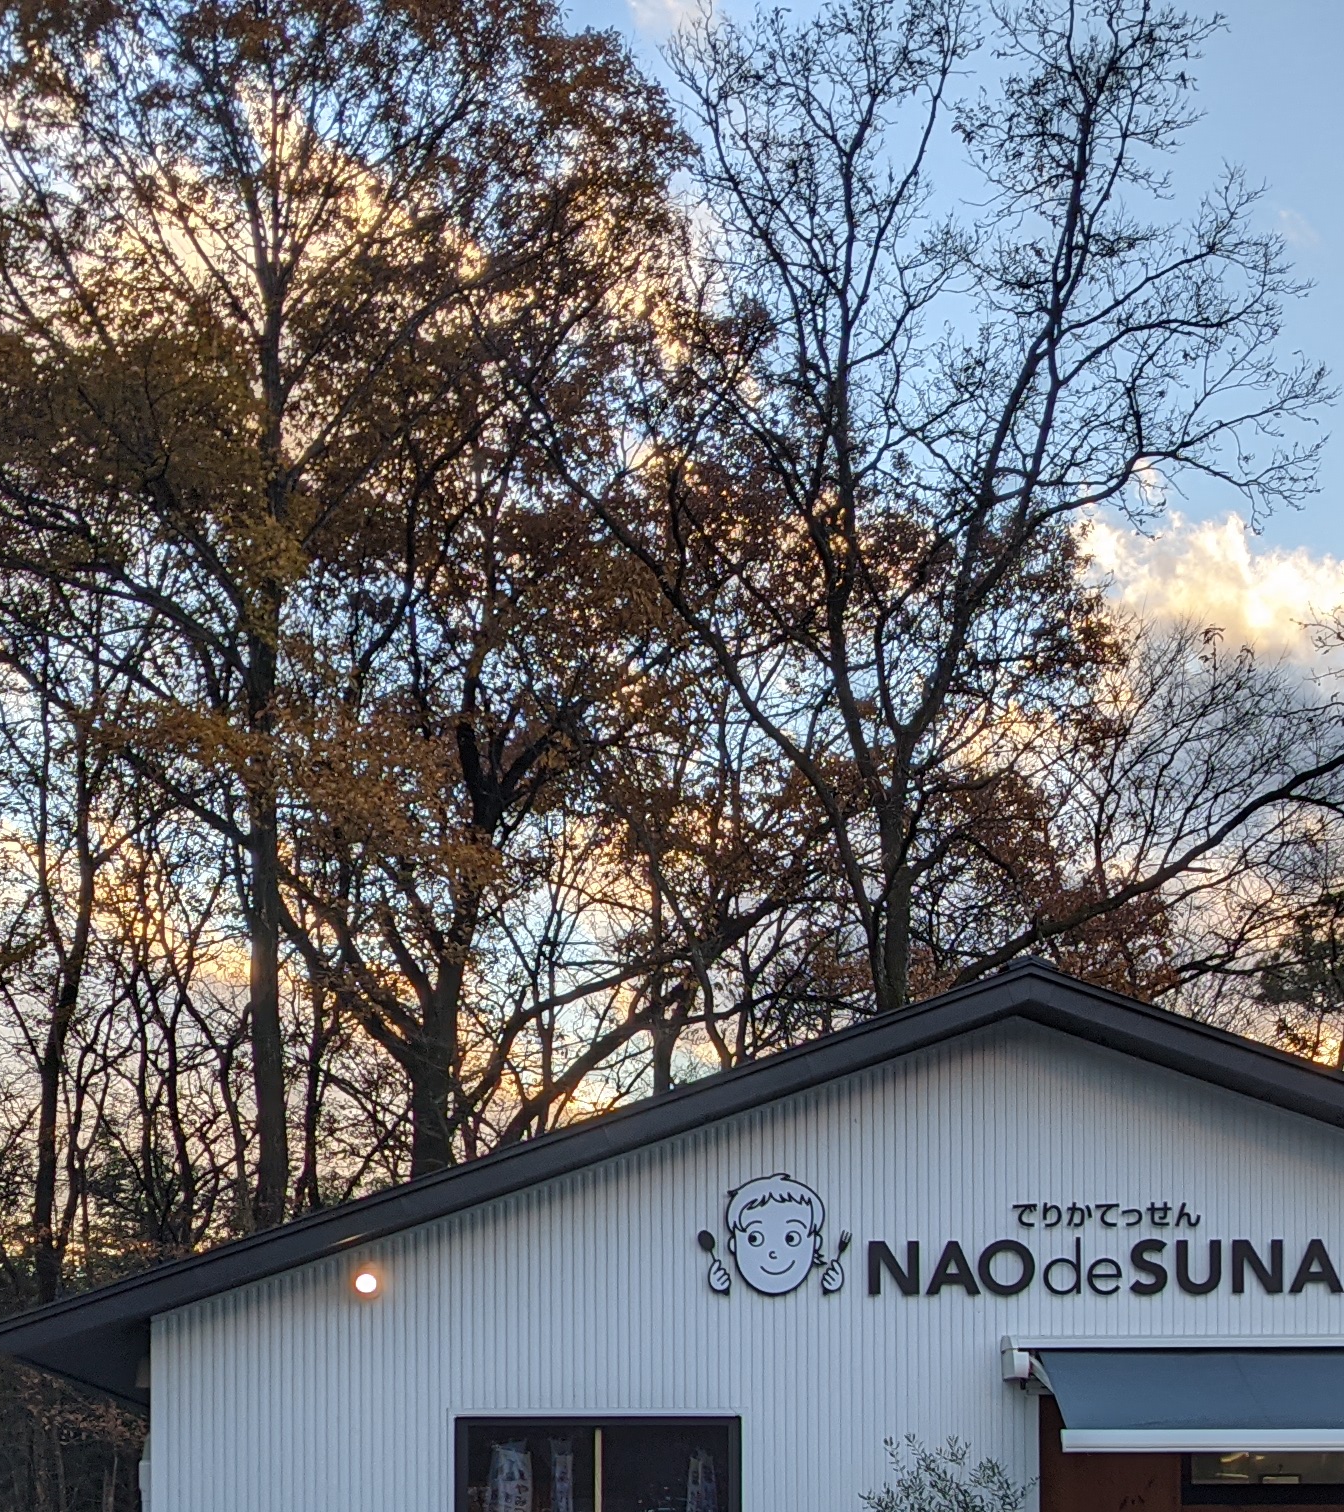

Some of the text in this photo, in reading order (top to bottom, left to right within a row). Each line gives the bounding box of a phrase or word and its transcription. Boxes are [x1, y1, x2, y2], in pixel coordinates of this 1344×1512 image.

[1012, 1201, 1201, 1228] でりかてっせん
